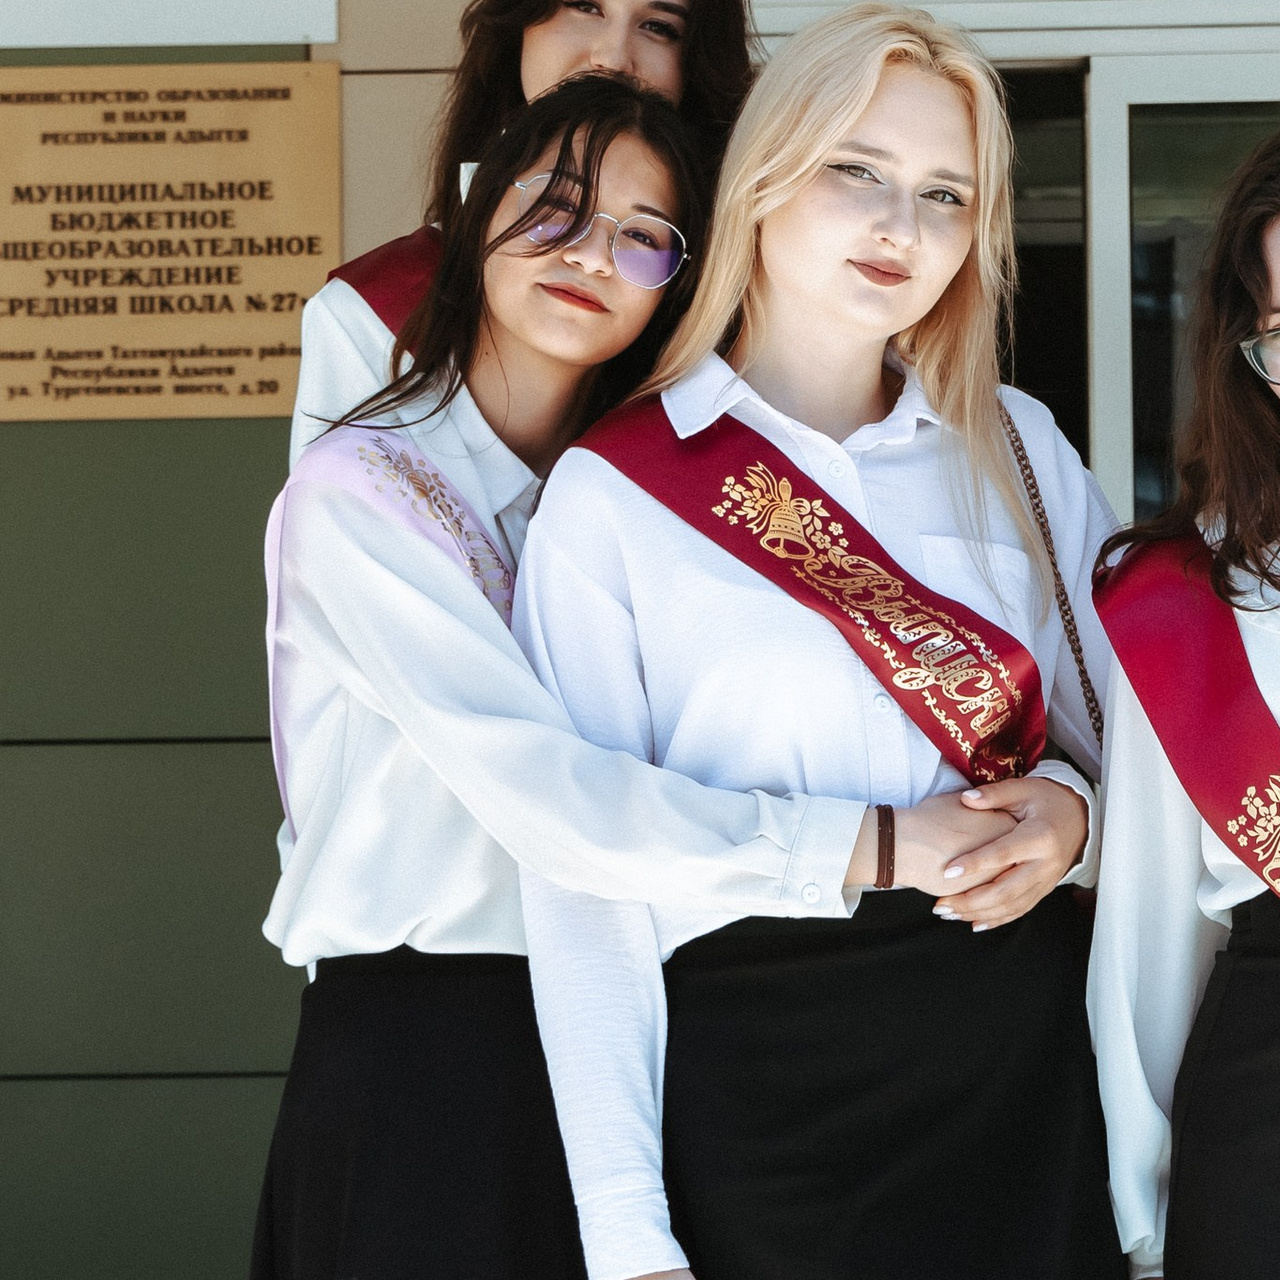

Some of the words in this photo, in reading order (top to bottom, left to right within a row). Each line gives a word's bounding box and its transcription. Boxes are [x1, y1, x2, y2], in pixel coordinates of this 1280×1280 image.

[12, 181, 273, 205] МУНИЦИПАЛЬНОЕ
[50, 210, 236, 233] БЮДЖЕТНОЕ
[0, 237, 322, 261] ЩЕОБРАЗОВАТЕЛЬНОЕ
[45, 266, 241, 289] УЧРЕЖДЕНИЕ
[130, 295, 234, 315] ШКОЛА
